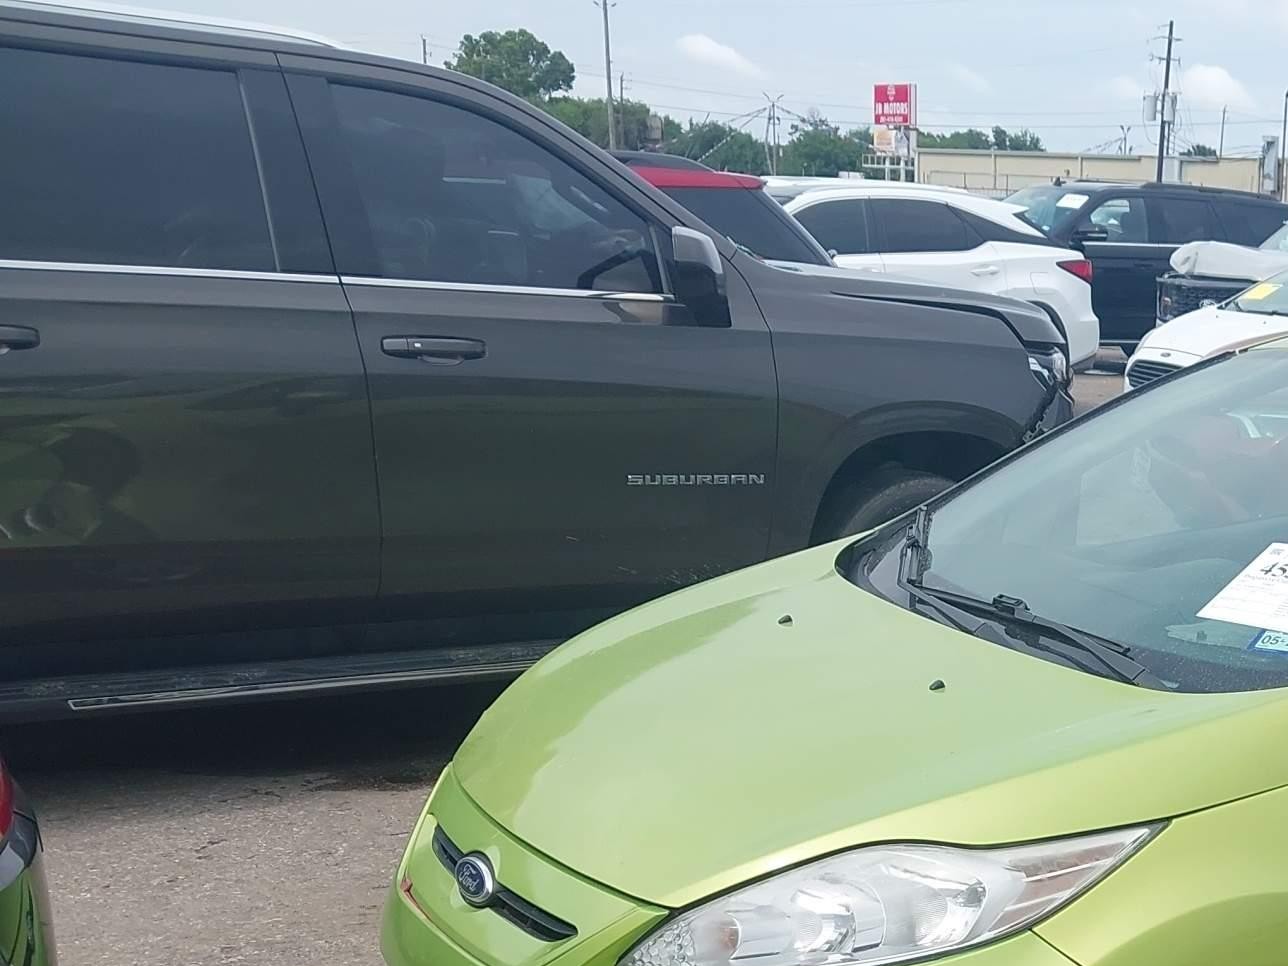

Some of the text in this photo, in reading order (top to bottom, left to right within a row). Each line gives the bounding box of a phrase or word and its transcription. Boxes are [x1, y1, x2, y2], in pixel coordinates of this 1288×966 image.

[884, 102, 908, 115] MOTORS
[627, 474, 765, 486] SUBURBAN
[459, 863, 480, 892] Ford
